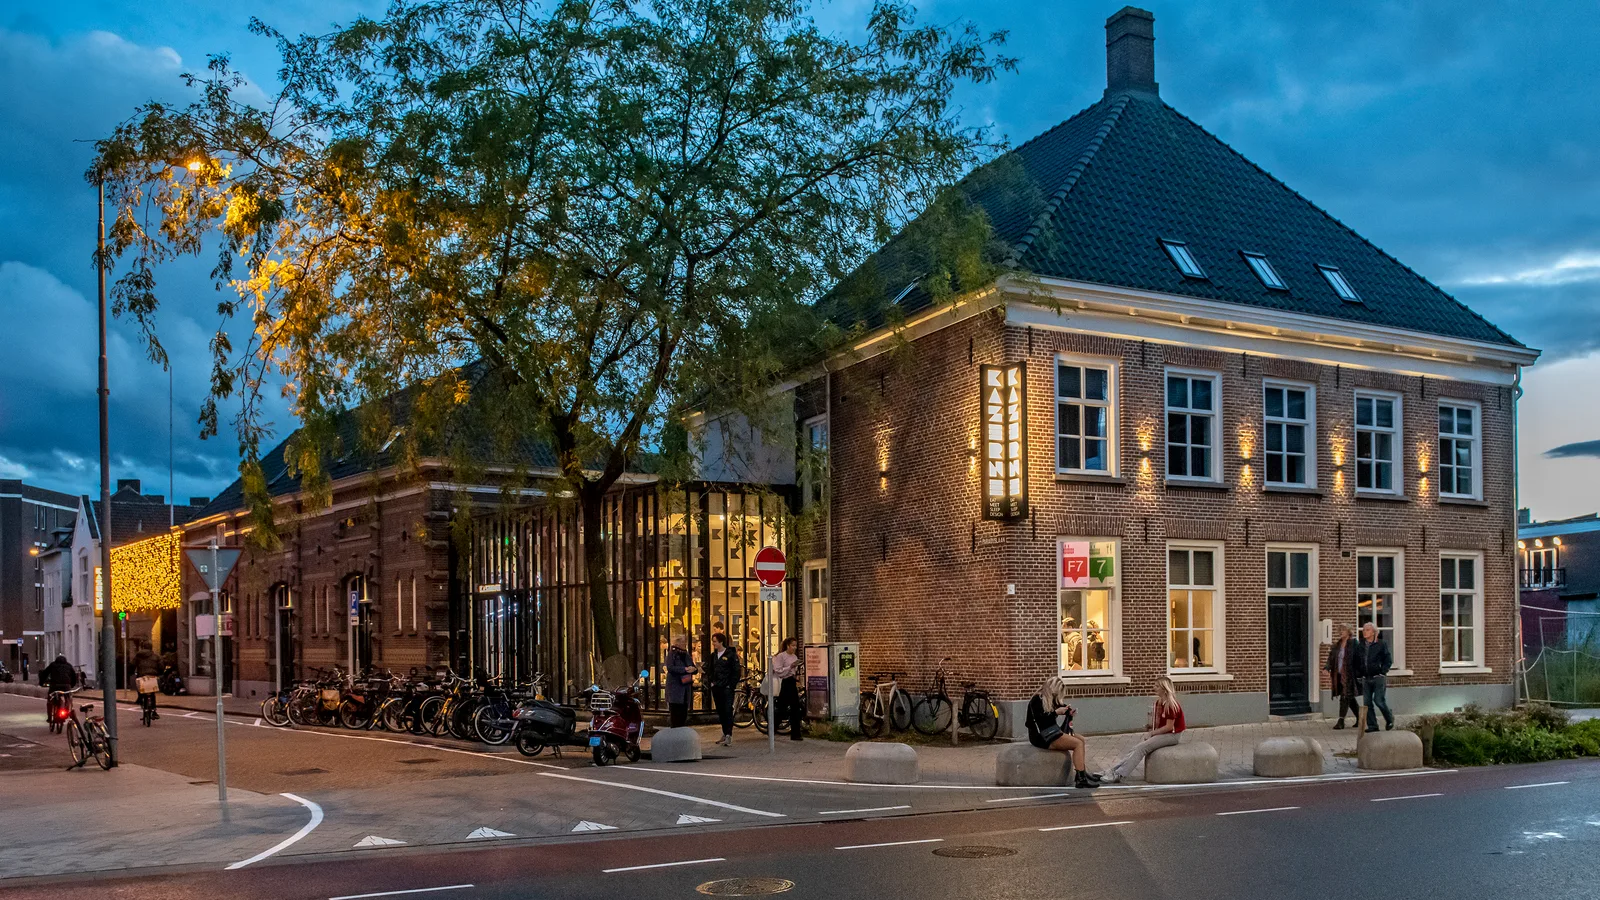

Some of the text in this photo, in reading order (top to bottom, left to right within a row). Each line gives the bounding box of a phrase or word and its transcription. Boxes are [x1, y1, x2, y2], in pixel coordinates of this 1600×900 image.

[987, 369, 1003, 496] KAZERNE
[1007, 367, 1020, 496] KAZERNE
[1067, 560, 1084, 572] F7
[1096, 559, 1107, 573] 7
